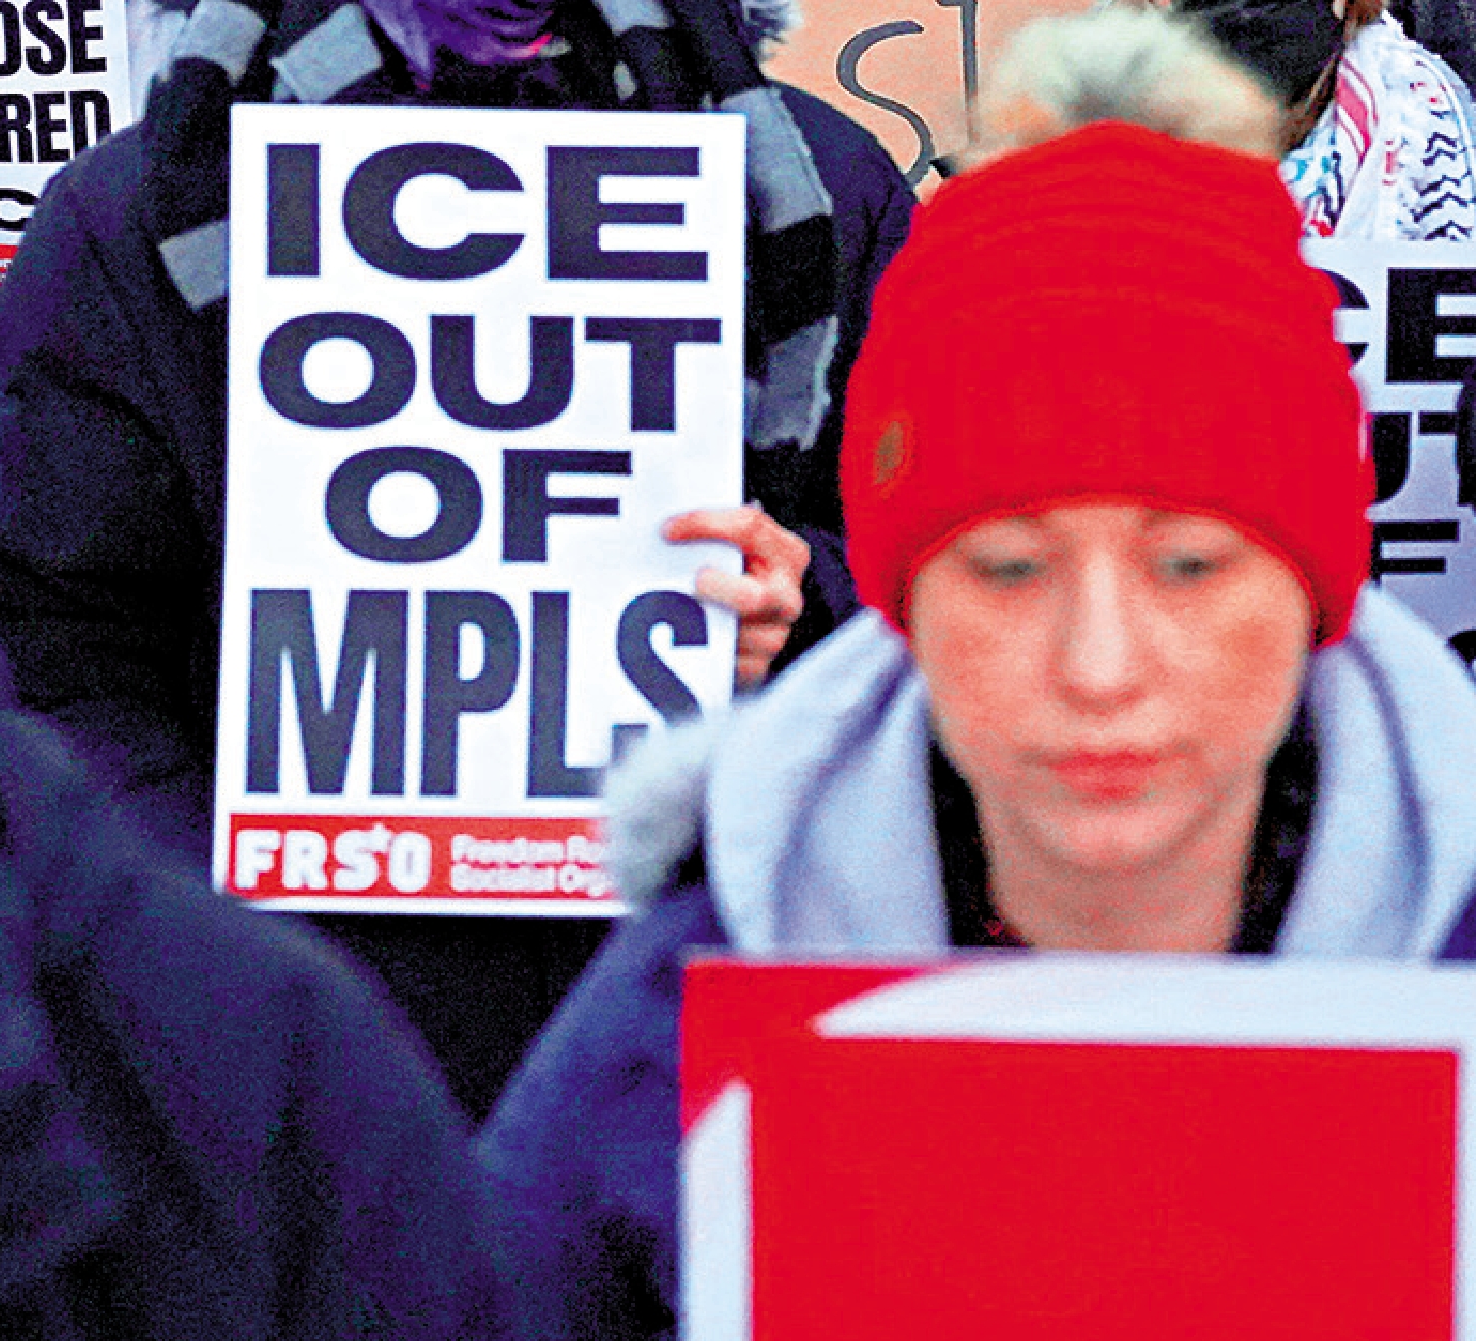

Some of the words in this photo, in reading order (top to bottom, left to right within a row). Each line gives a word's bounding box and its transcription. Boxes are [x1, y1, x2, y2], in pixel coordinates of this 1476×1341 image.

[266, 142, 710, 283] ICE
[258, 311, 723, 434] OUT
[323, 445, 633, 564] OF
[244, 587, 711, 800] MPLS
